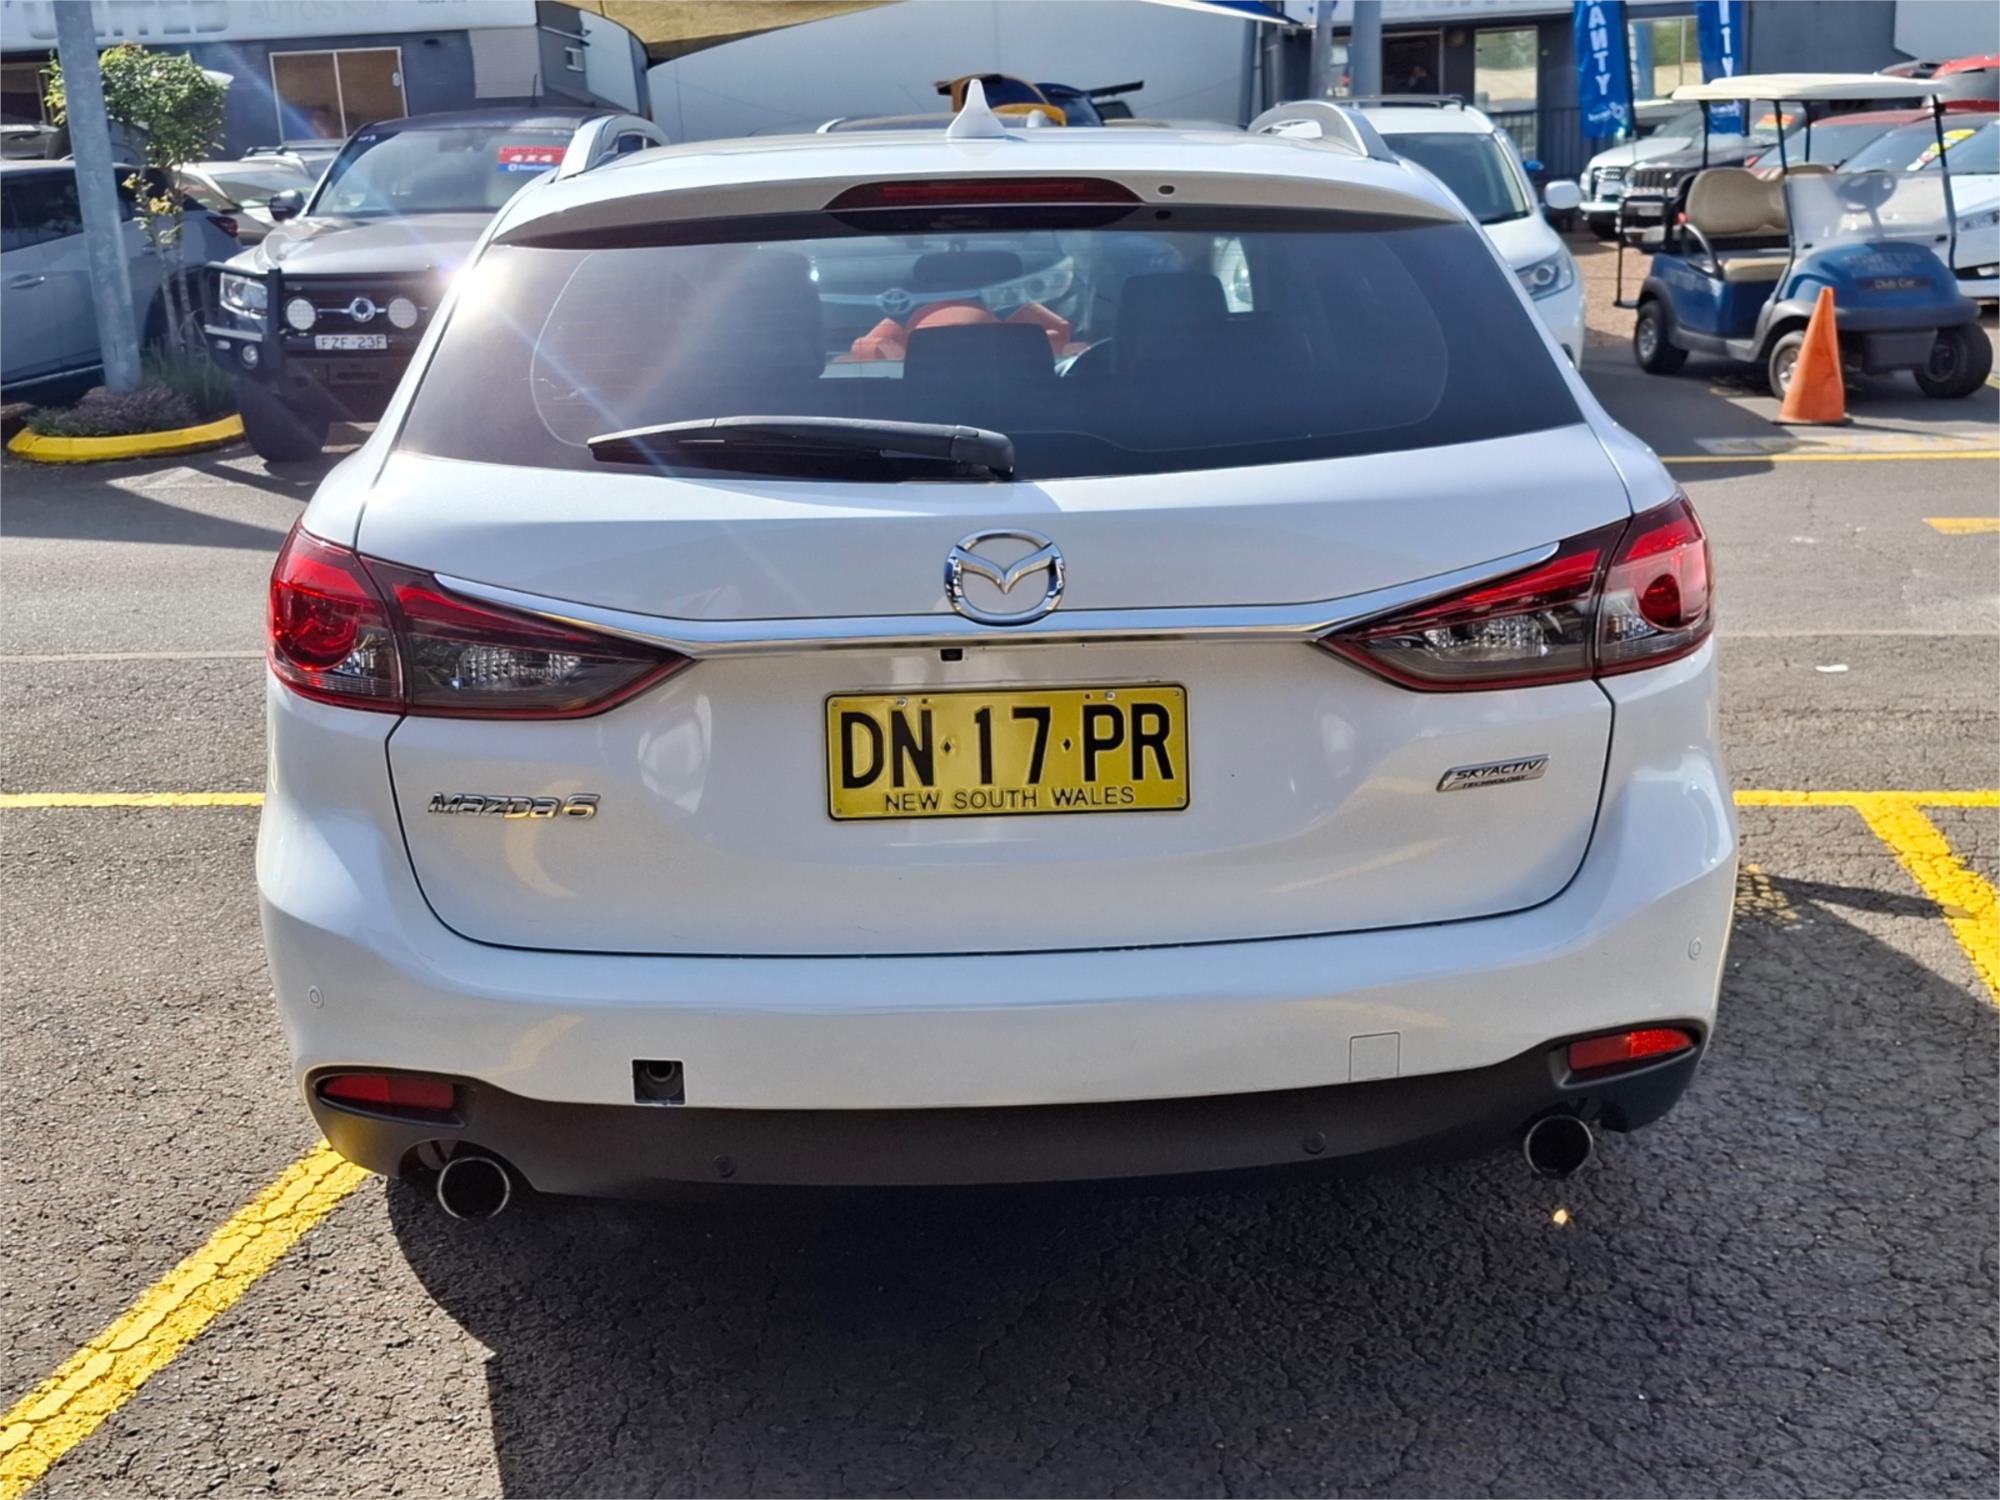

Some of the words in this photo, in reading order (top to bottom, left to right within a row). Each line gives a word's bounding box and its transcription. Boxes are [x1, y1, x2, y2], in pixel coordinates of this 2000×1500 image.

[1587, 0, 1611, 95] ANTY
[1455, 760, 1543, 780] SKYACTIV
[885, 790, 942, 812] NEW
[954, 788, 1037, 809] SOUTH
[1051, 785, 1135, 807] WALES
